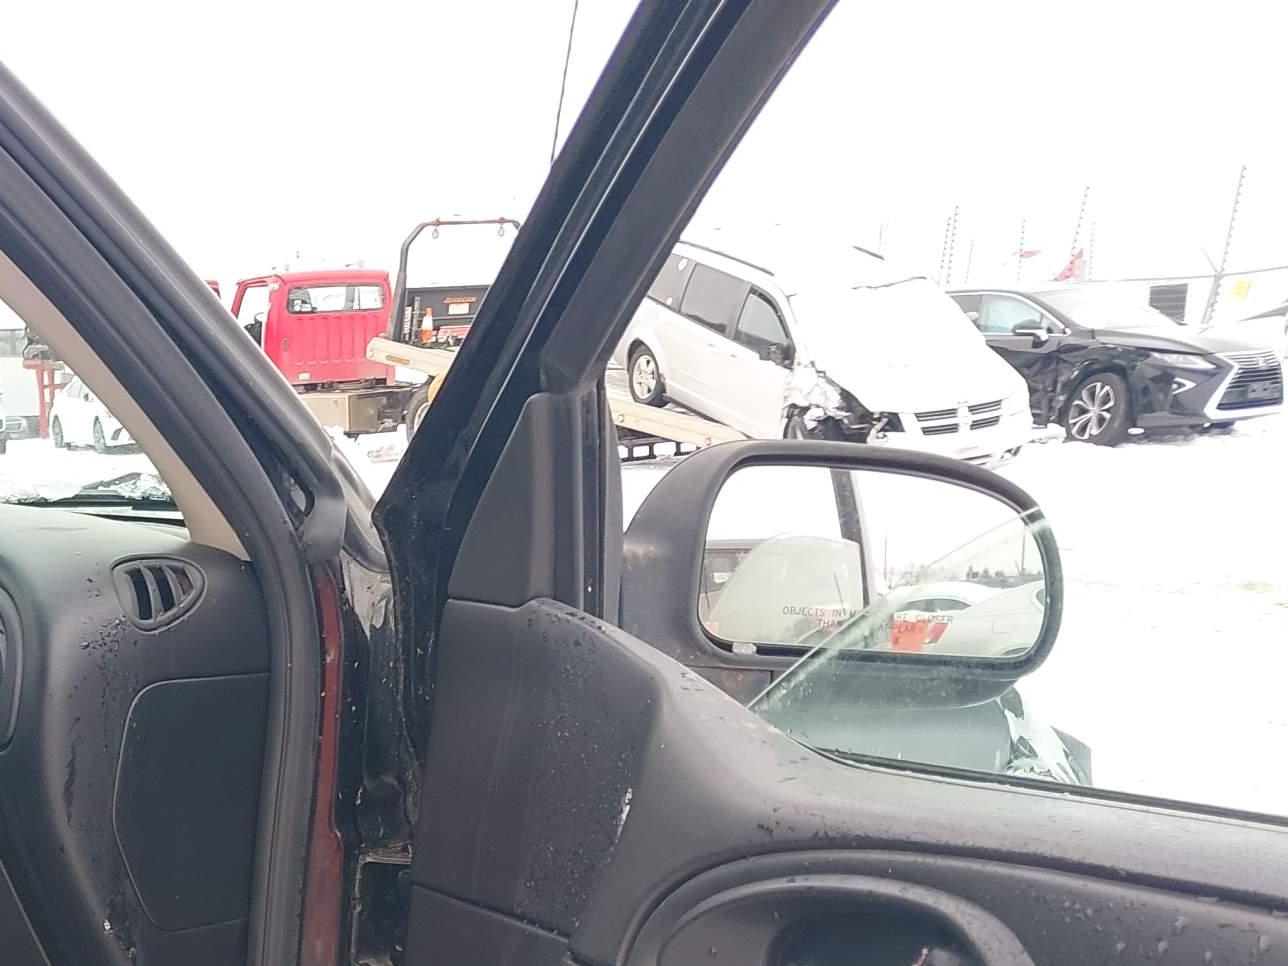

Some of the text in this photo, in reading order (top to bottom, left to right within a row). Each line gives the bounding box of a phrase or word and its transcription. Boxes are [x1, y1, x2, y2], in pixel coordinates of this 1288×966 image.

[781, 605, 826, 617] OBJECTS
[832, 607, 842, 617] IN
[915, 613, 955, 624] CLOSER
